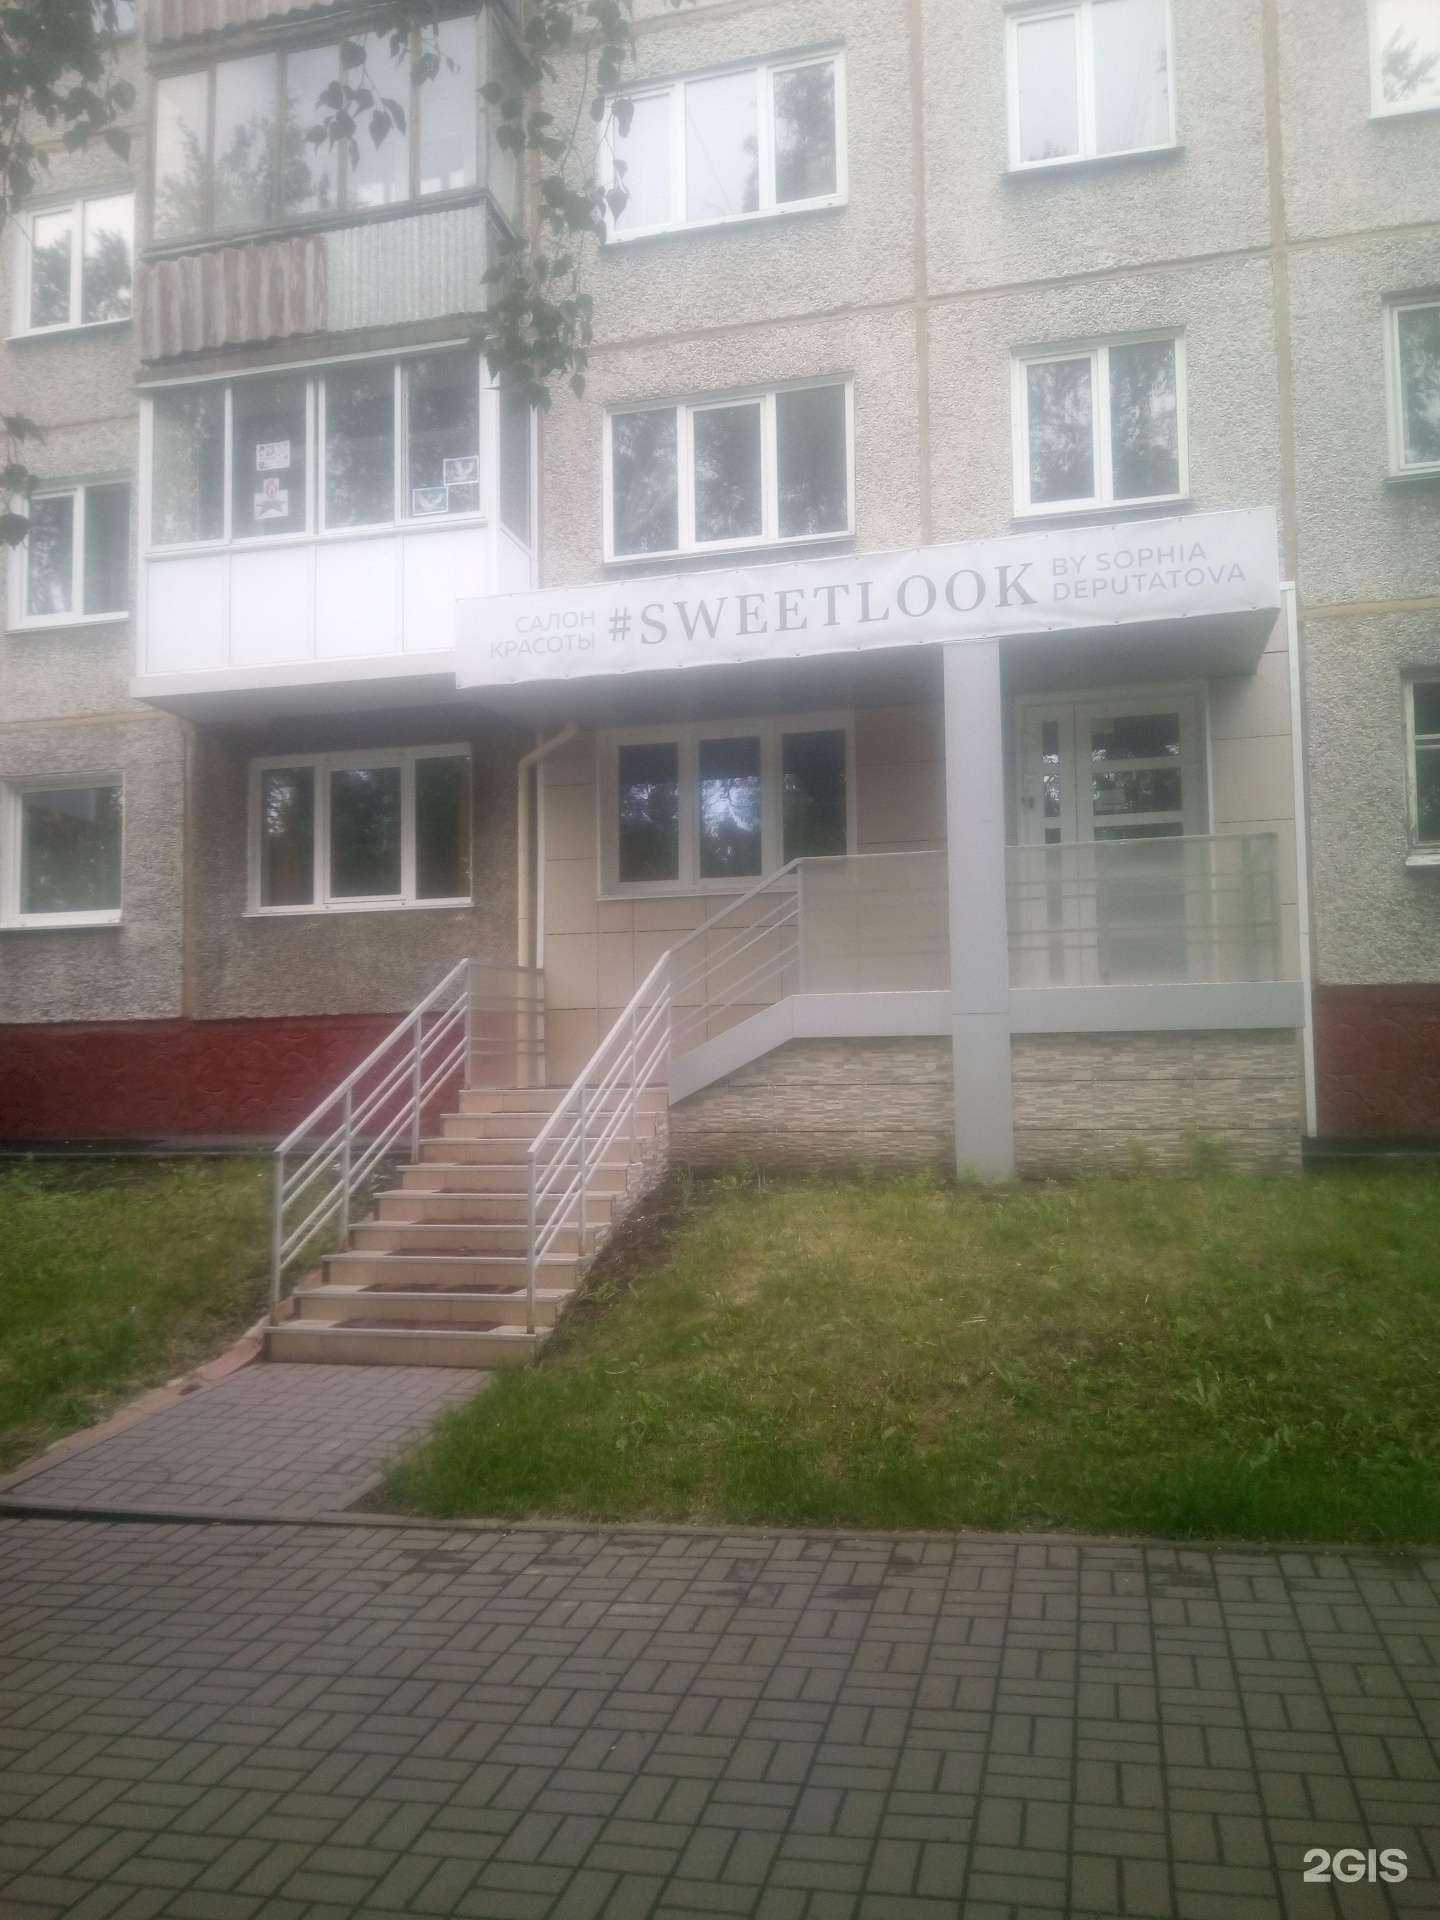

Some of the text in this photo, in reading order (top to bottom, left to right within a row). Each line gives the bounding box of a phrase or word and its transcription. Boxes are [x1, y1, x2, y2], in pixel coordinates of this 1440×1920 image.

[1052, 542, 1207, 577] BY SOPHIA
[1053, 563, 1247, 602] DEPUTATOVA
[607, 561, 1038, 645] #SWEETLOOK
[515, 610, 595, 634] САЛОН
[489, 633, 595, 659] КРАСОТЫ
